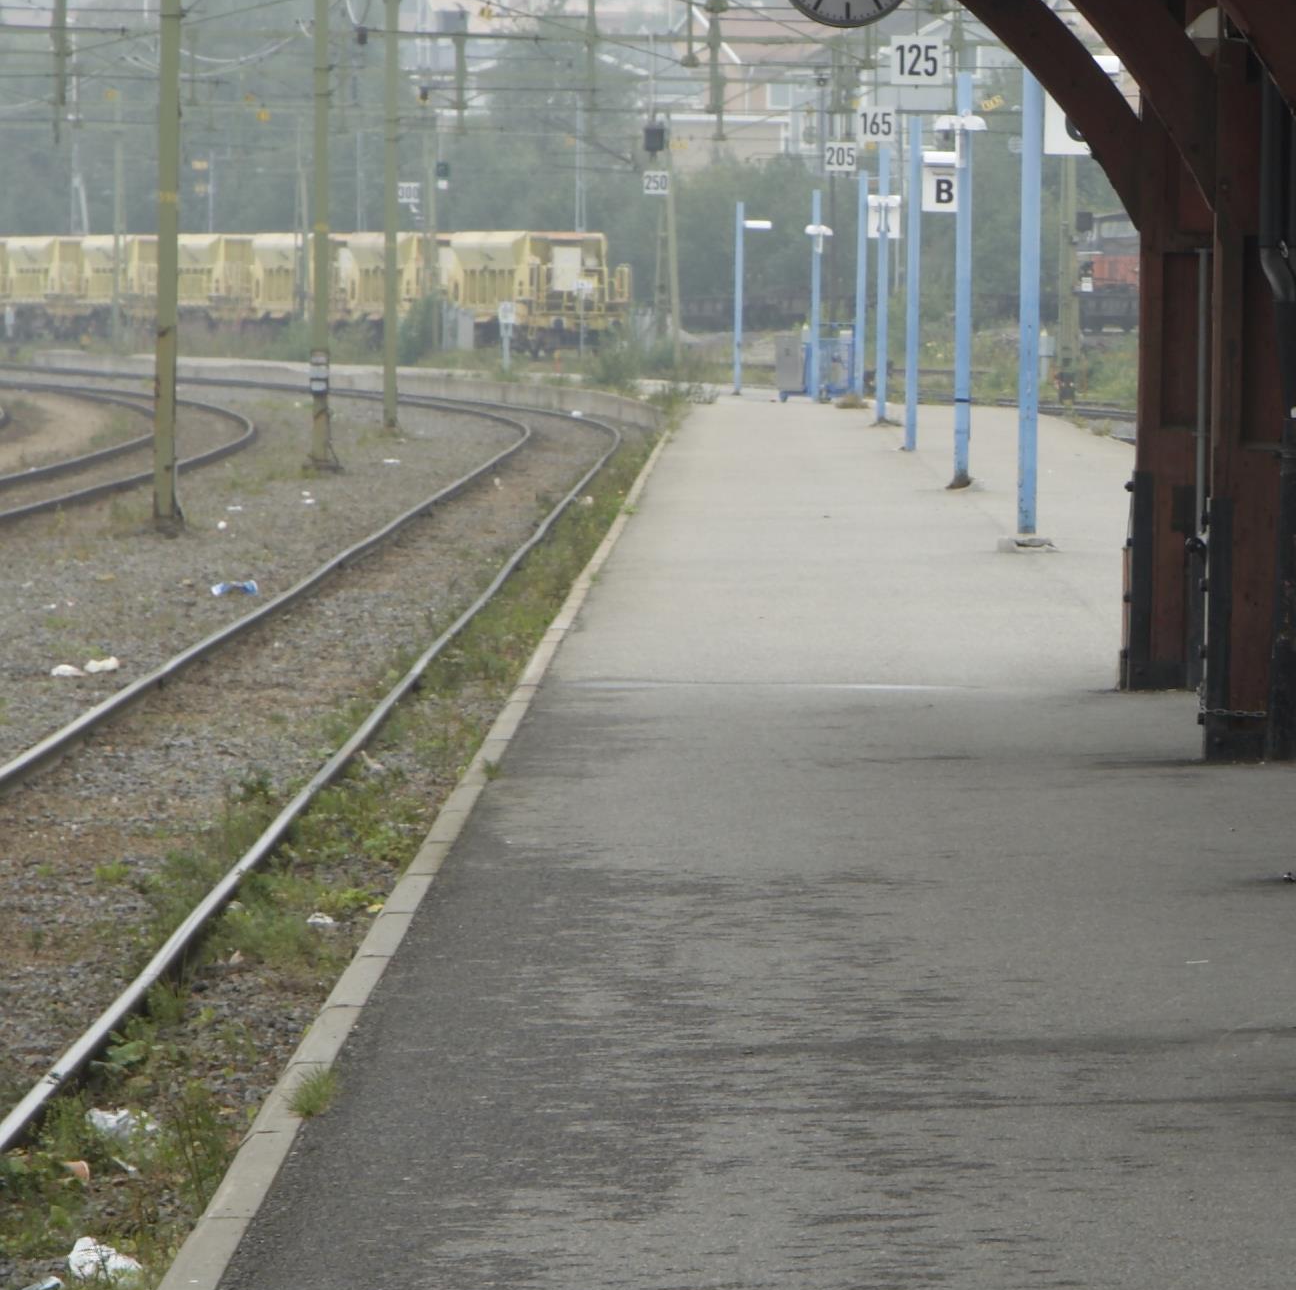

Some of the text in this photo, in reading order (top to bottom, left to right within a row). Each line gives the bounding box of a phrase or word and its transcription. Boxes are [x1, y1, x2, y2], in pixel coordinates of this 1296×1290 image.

[896, 45, 938, 77] 125
[860, 112, 893, 137] 165
[826, 146, 855, 166] 205
[644, 174, 668, 191] 250
[935, 179, 954, 204] B
